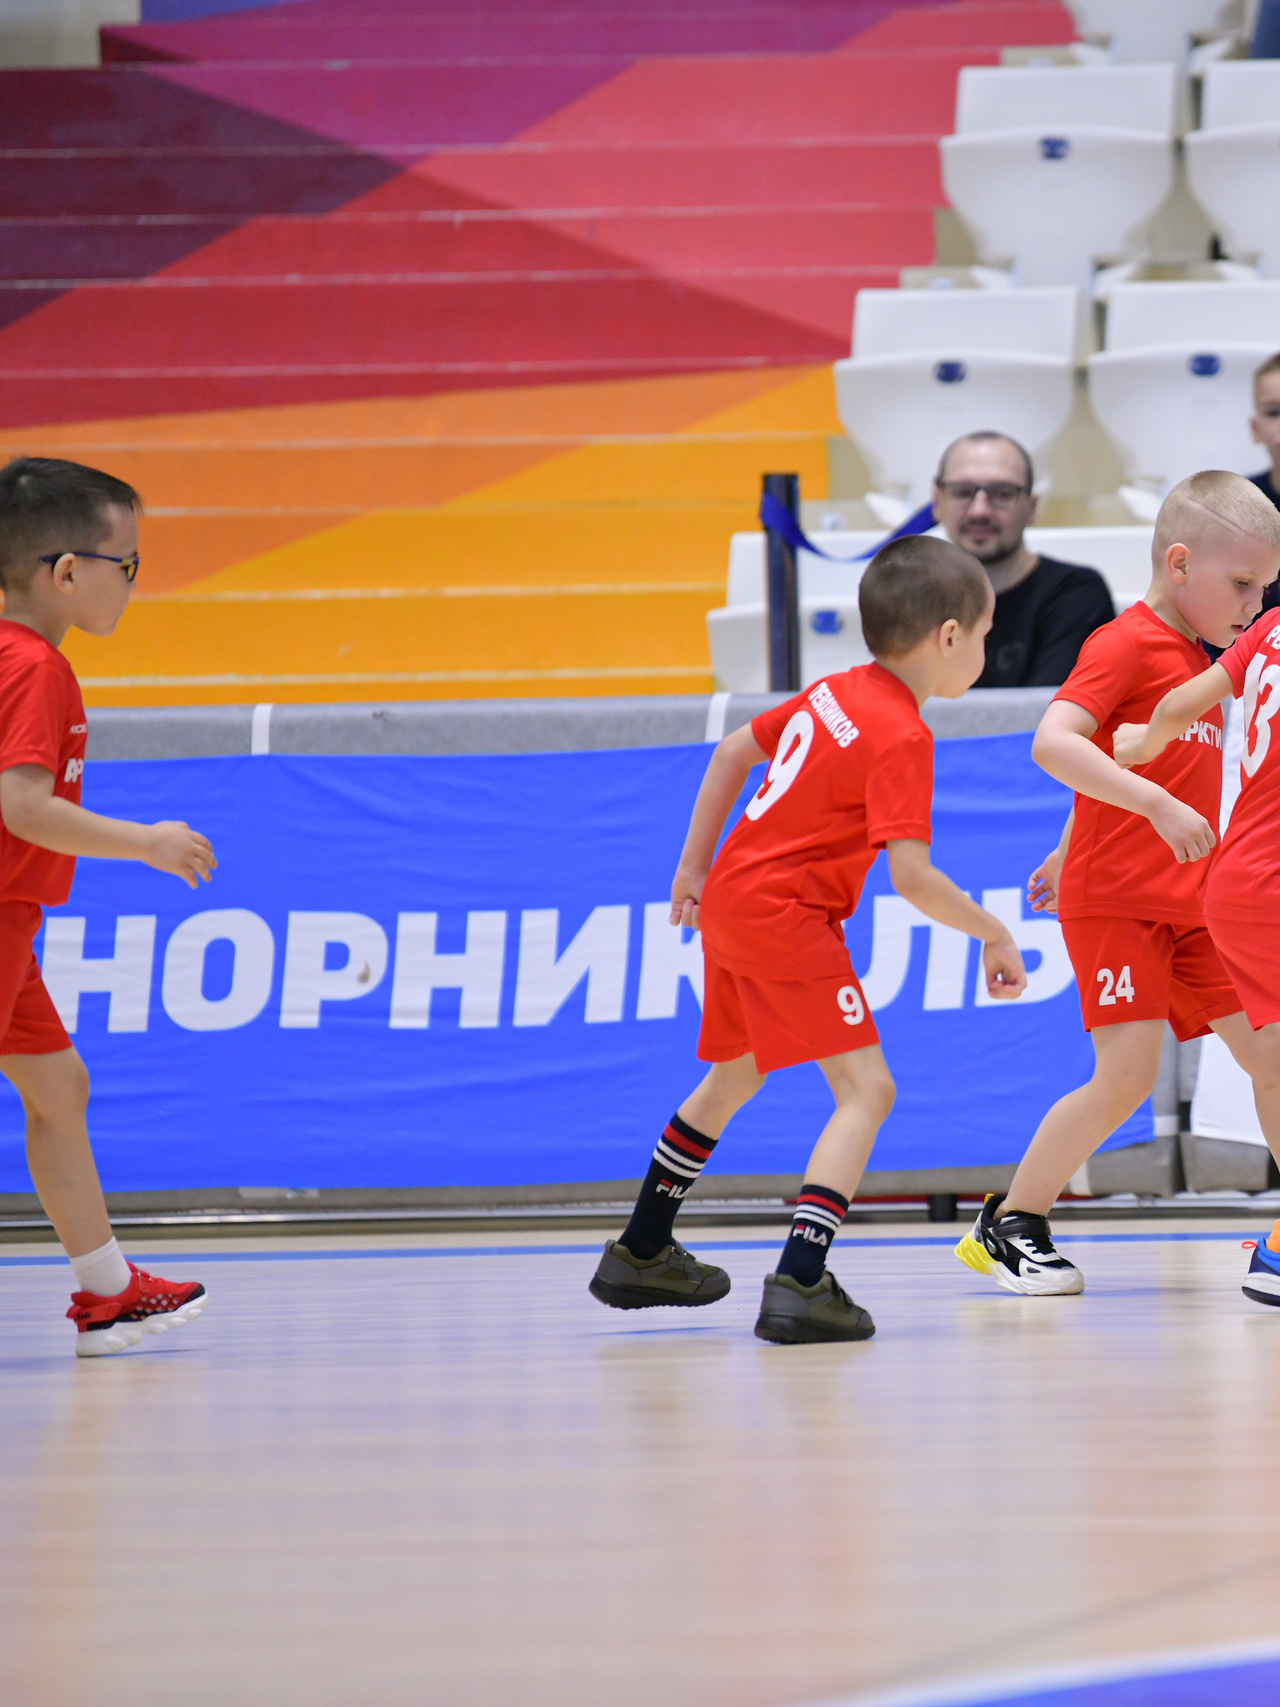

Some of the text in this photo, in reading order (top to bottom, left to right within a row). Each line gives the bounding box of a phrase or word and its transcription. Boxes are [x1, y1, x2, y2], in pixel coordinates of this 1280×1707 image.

[1179, 720, 1222, 751] РКТИ
[745, 710, 815, 821] 9
[40, 887, 1076, 1033] НОРНИКЛЬ
[836, 985, 865, 1026] 9
[1096, 965, 1135, 1006] 24
[792, 1224, 828, 1247] FILA
